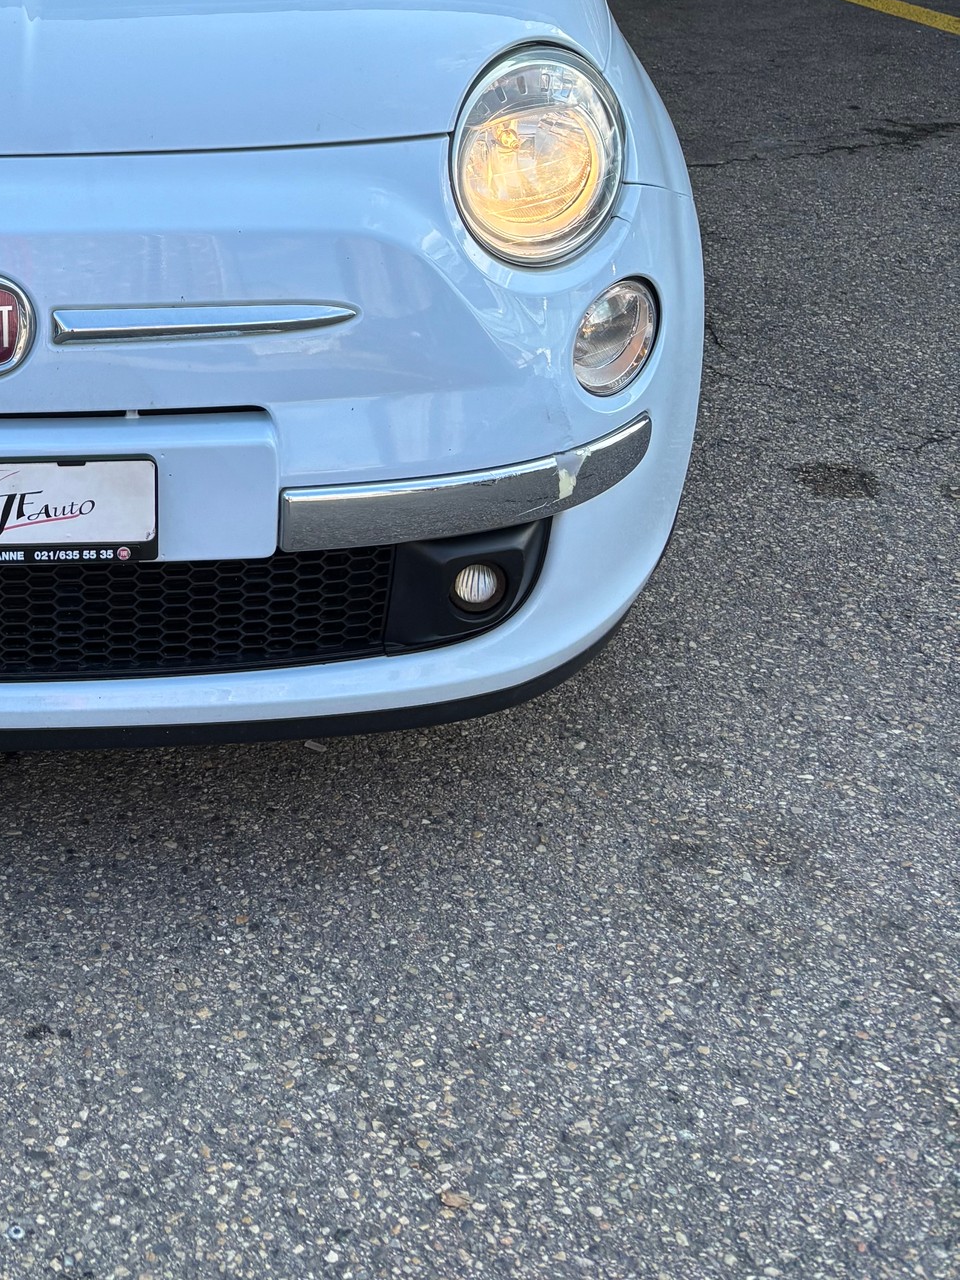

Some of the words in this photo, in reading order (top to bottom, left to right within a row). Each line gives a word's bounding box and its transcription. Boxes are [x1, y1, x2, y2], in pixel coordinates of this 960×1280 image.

[34, 550, 79, 561] 021/635
[82, 549, 96, 559] 55
[99, 549, 114, 559] 35
